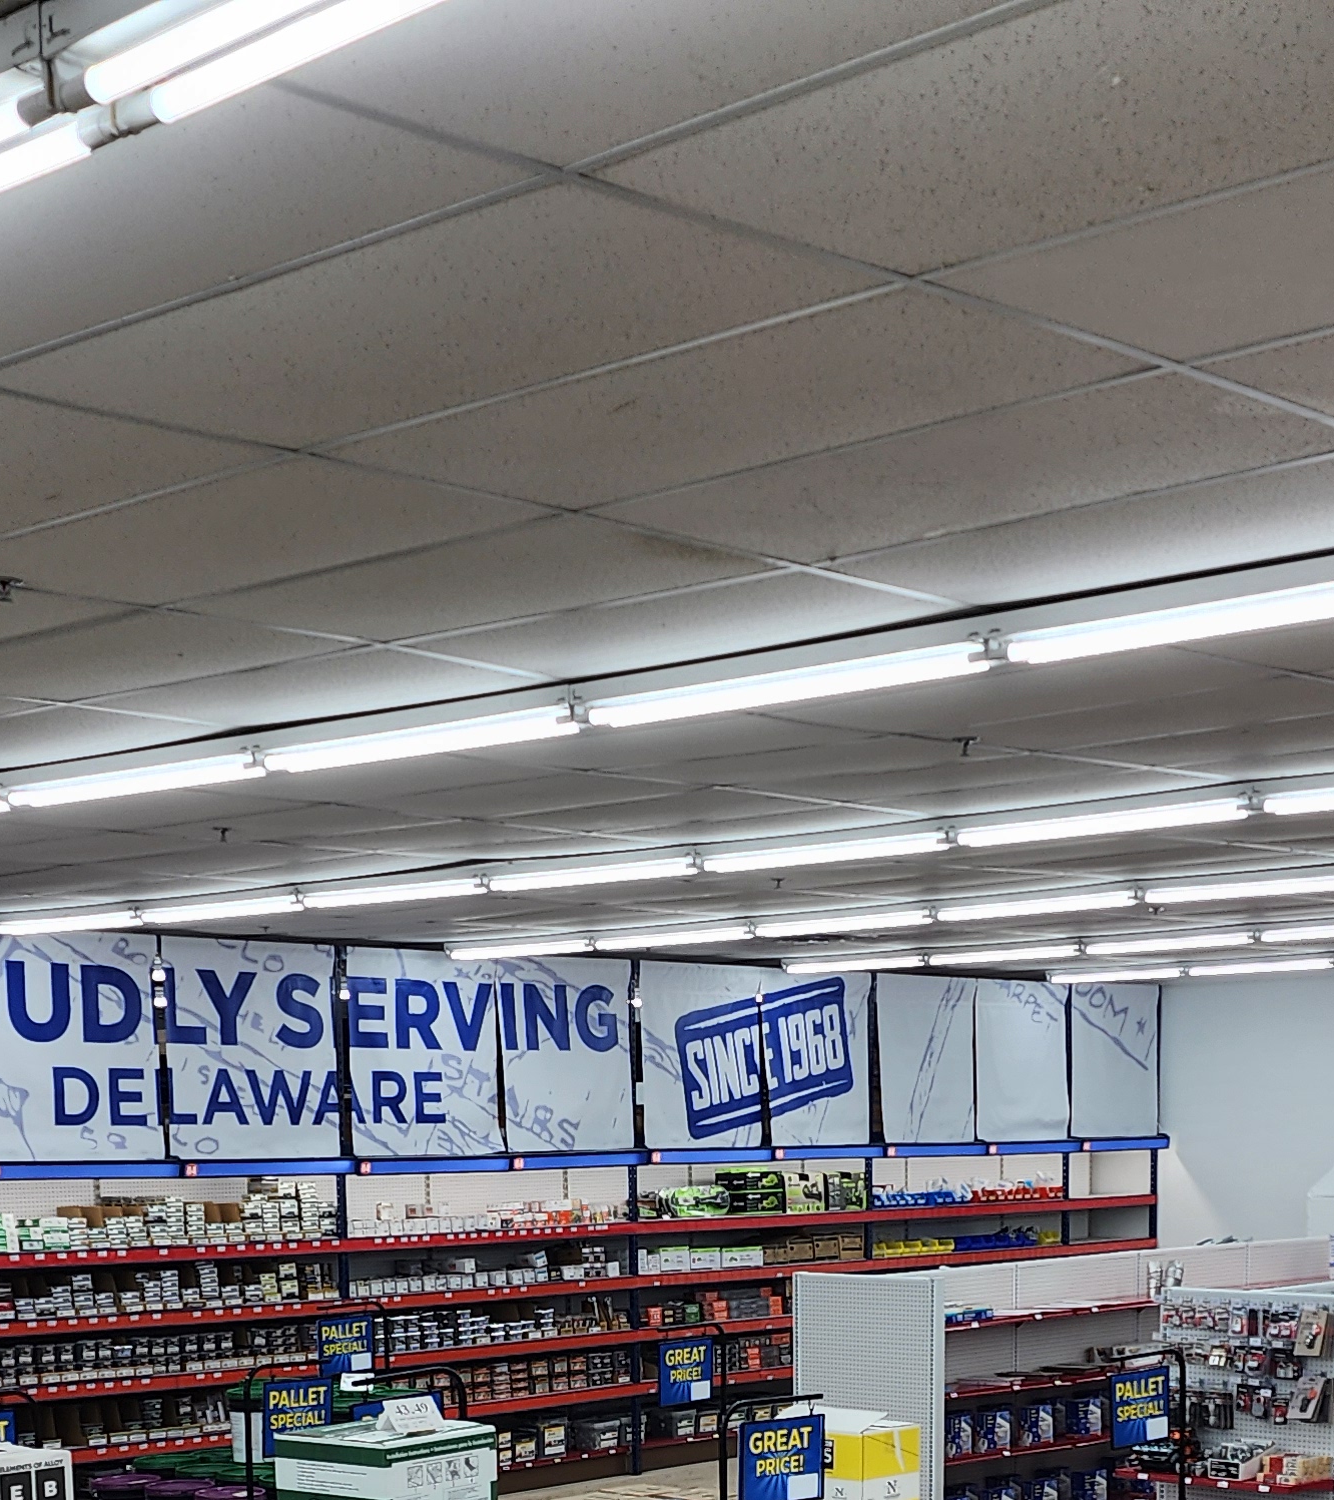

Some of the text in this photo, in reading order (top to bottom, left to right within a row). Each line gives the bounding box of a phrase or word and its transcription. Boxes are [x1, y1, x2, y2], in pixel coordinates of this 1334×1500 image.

[275, 973, 619, 1054] SERVING
[685, 1003, 845, 1112] SINCE 1968
[52, 1066, 447, 1126] DELAWARE
[321, 1322, 367, 1340] PALLET
[323, 1338, 367, 1355] SPECIAL!
[665, 1345, 707, 1365] GREAT
[670, 1366, 702, 1381] PRICE!
[269, 1387, 327, 1409] PALLET
[1115, 1376, 1165, 1399] PALLET
[270, 1410, 325, 1429] SPECIAL!
[395, 1402, 429, 1416] 43.49
[1117, 1400, 1164, 1422] SPECIAL!
[749, 1427, 812, 1454] GREAT
[0, 1459, 64, 1474] ELEMENTS OF ALLOY
[755, 1455, 805, 1477] PRICE!
[44, 1480, 58, 1498] B
